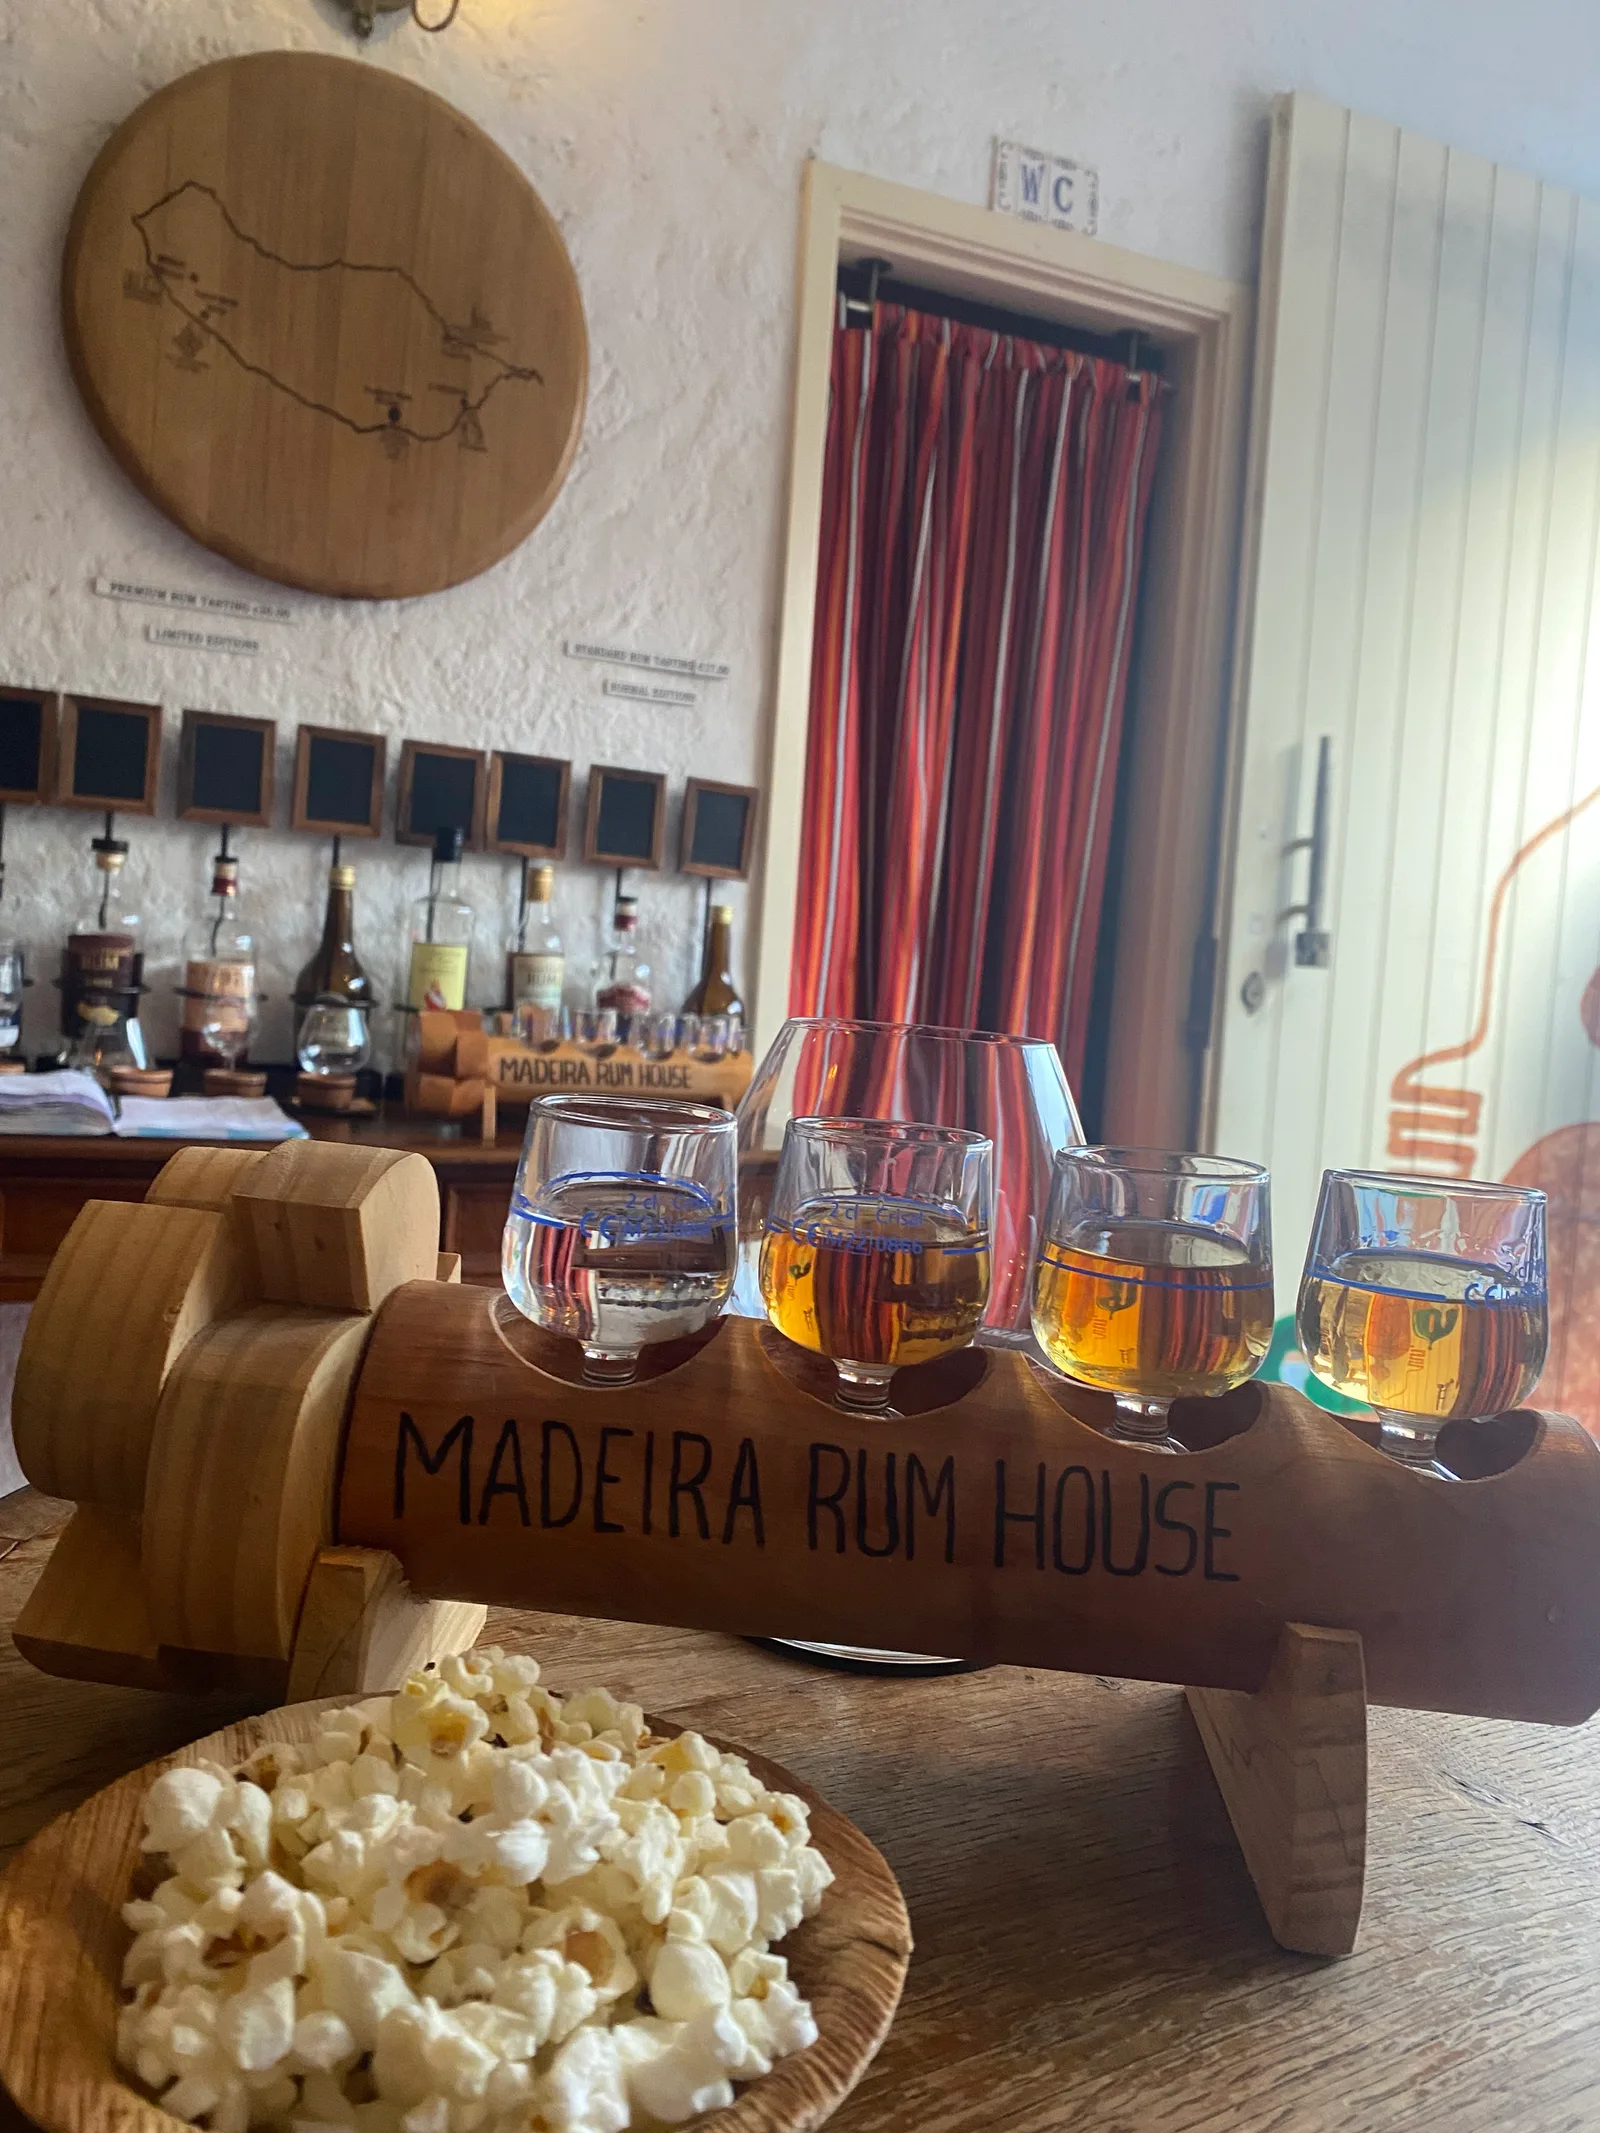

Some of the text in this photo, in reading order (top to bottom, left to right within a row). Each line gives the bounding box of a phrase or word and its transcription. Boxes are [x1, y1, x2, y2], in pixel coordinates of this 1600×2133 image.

[1021, 163, 1074, 213] WC
[110, 582, 167, 599] PREMIUM
[170, 591, 197, 604] RUM
[155, 628, 260, 650] LIMITED EDITIONS
[575, 643, 627, 661] STANDARD
[610, 682, 697, 701] NORMAL EDITIONS
[500, 1057, 692, 1089] MADEIRA RUM HOUSE
[829, 1201, 924, 1228] 2 cl Crisal
[393, 1411, 1242, 1583] MADEIRA RUM HOUSE
